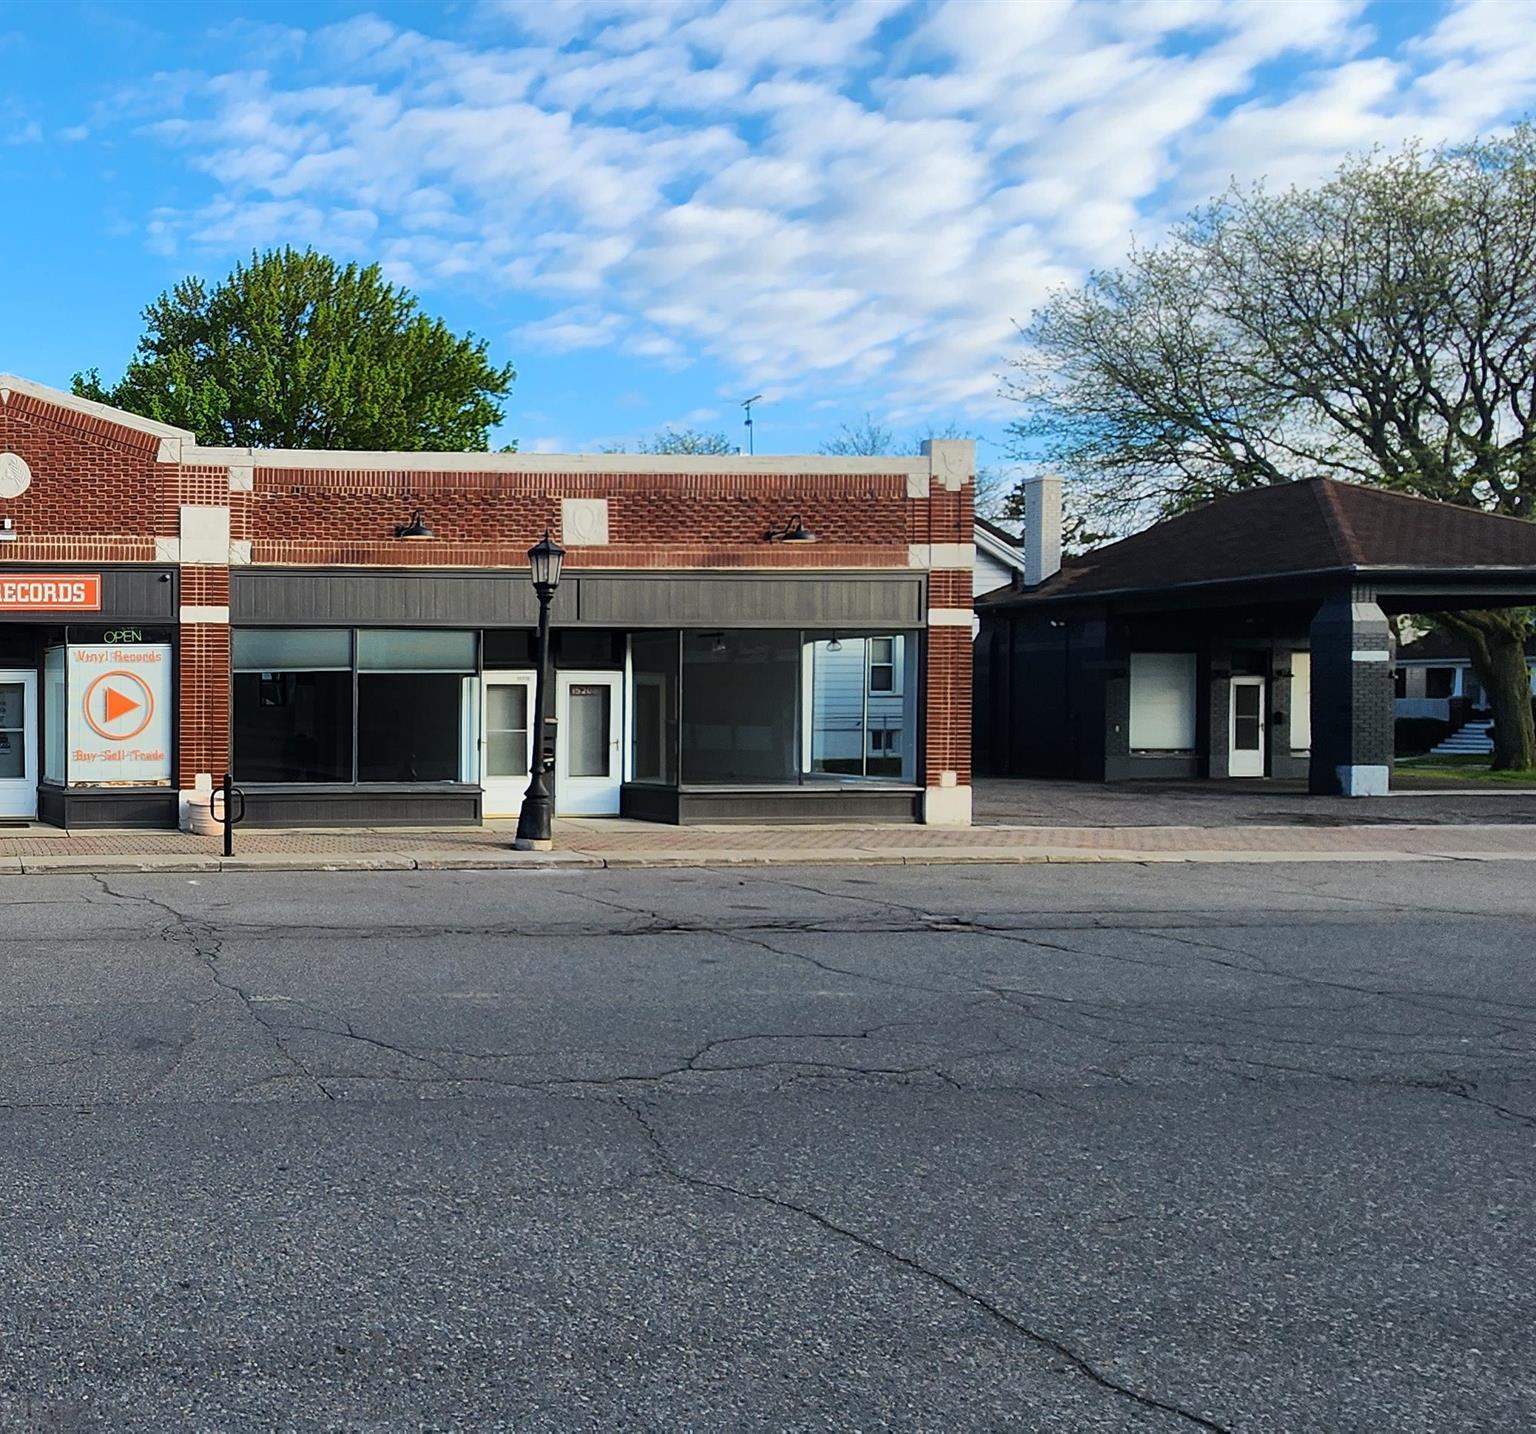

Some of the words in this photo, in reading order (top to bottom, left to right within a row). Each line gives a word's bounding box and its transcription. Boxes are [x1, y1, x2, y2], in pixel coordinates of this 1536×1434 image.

[104, 630, 142, 643] OPEN
[76, 650, 109, 663] Vinyl
[113, 650, 162, 663] Records
